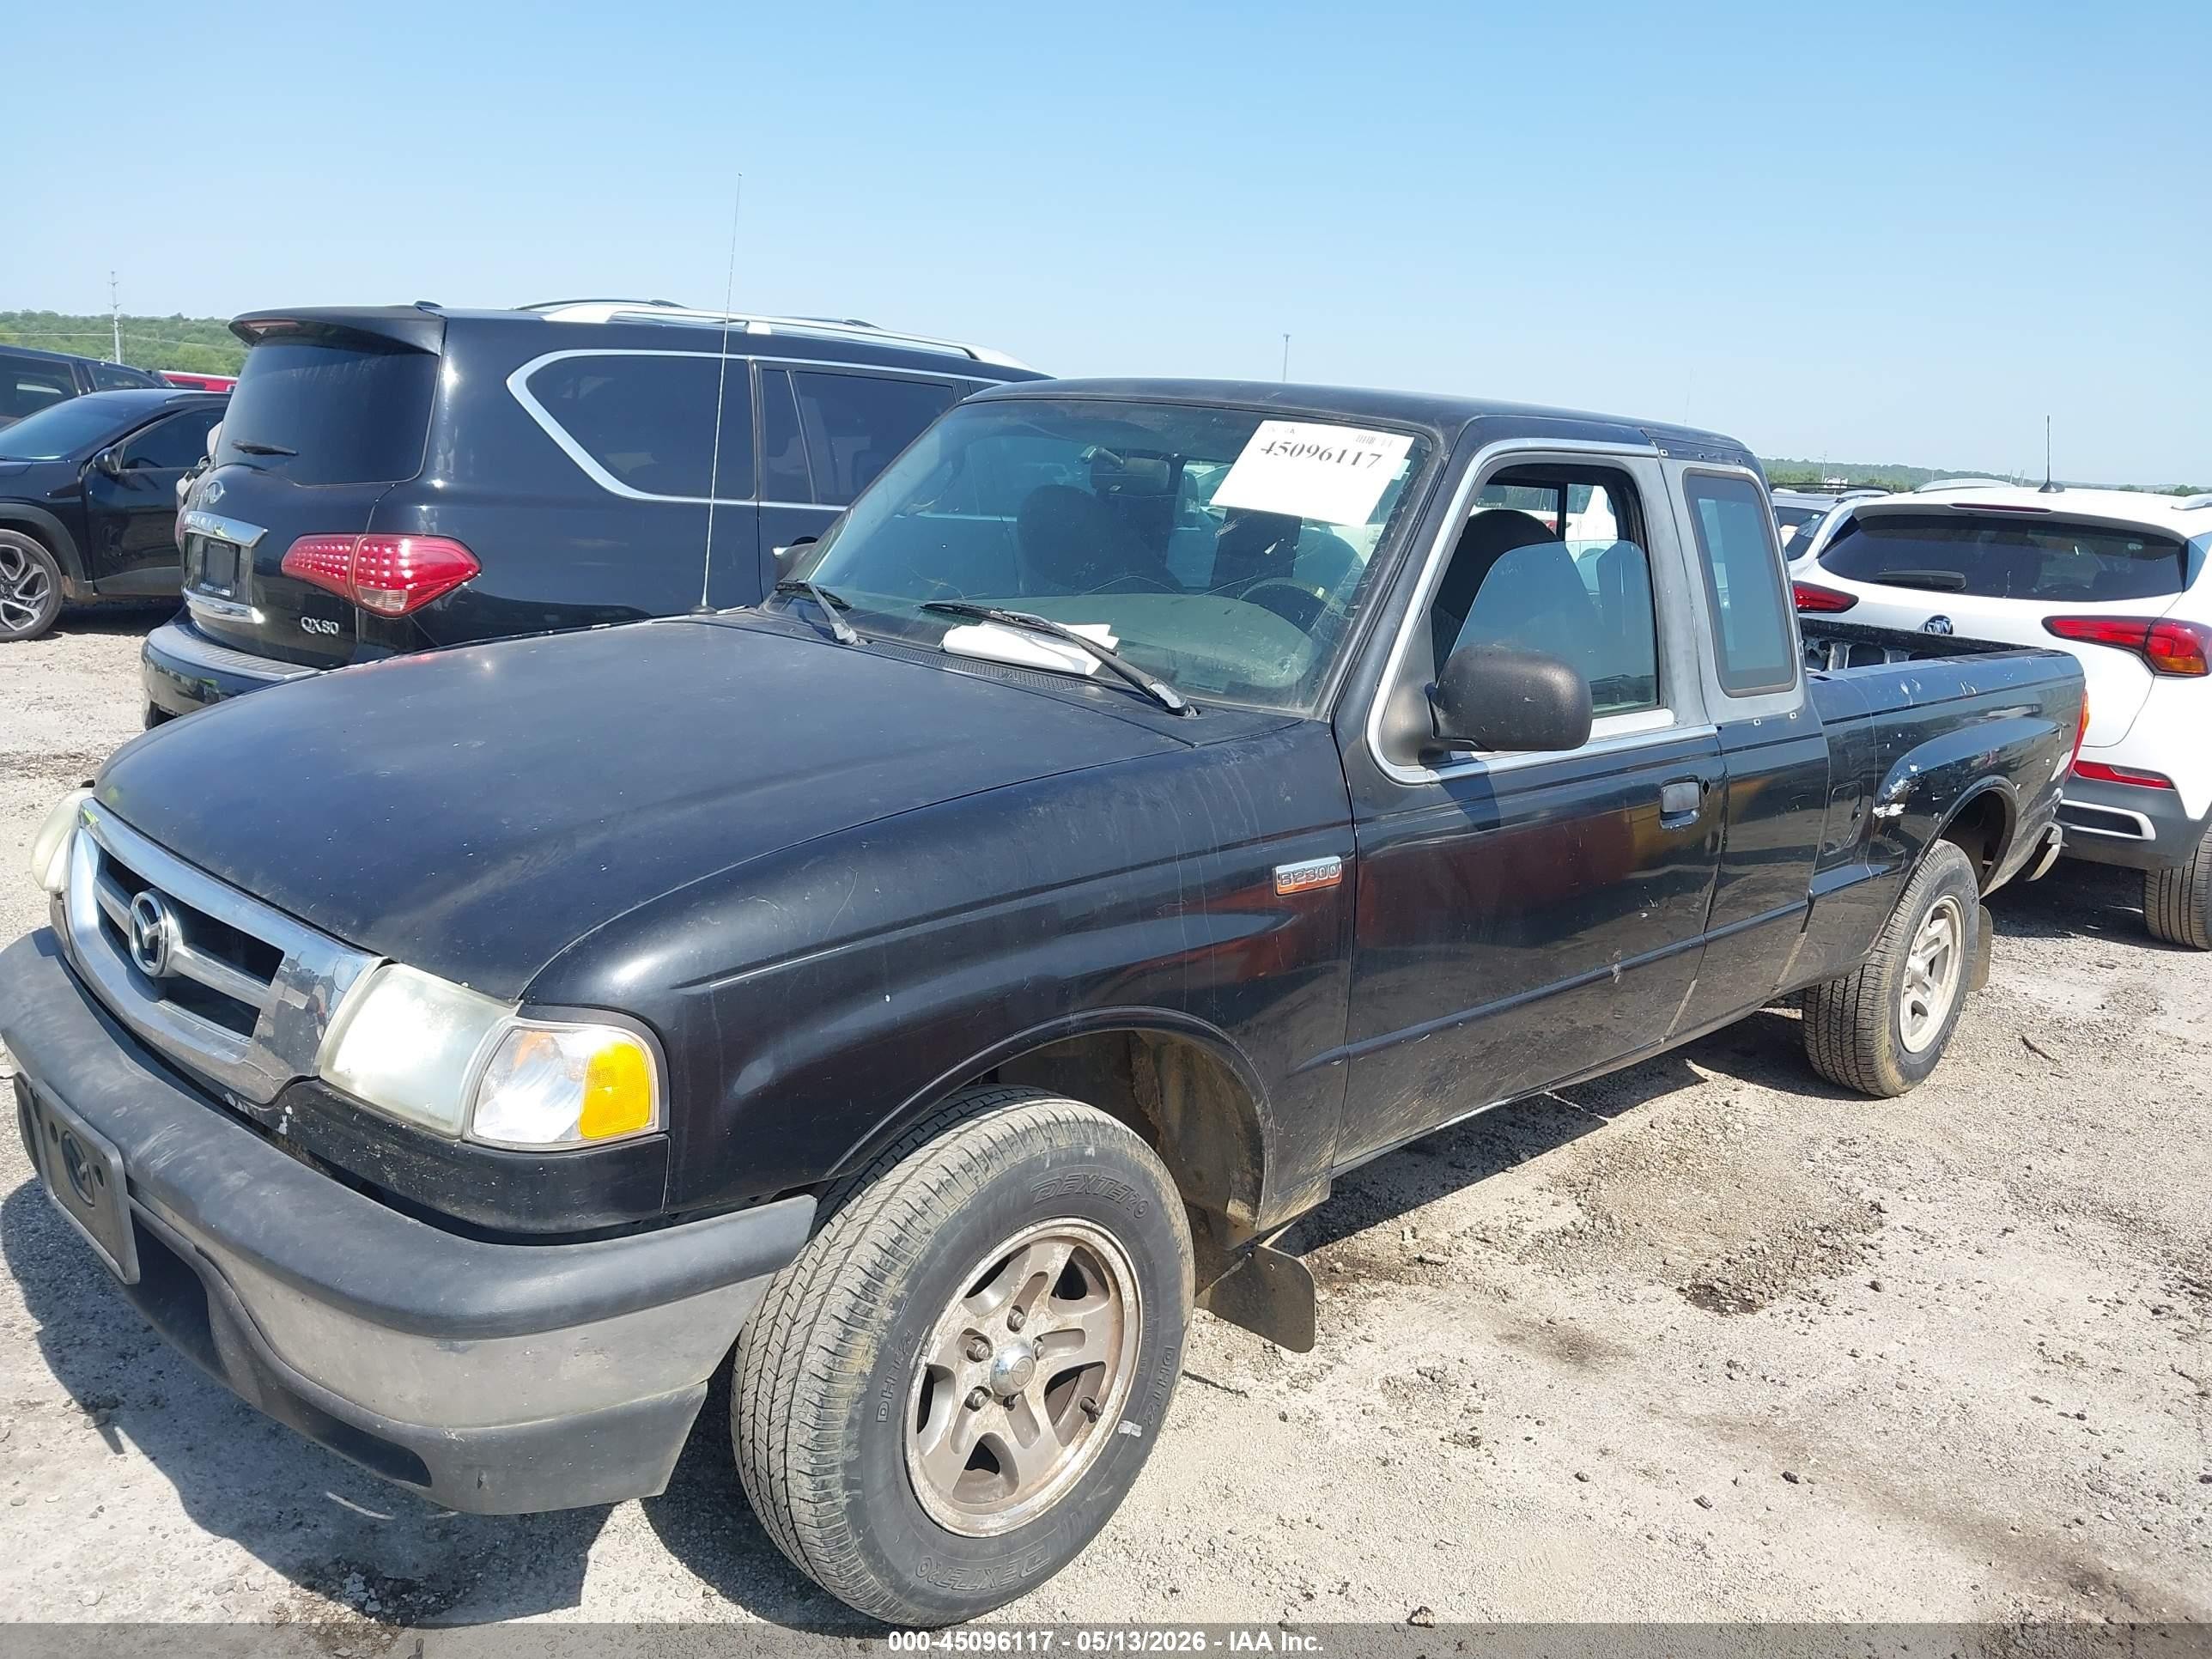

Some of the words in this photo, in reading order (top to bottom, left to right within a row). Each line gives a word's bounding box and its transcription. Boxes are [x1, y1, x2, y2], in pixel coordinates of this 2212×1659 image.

[1260, 440, 1383, 469] 45096117
[1030, 1173, 1149, 1219] DEXTERO
[915, 1545, 1053, 1591] DEXTERO
